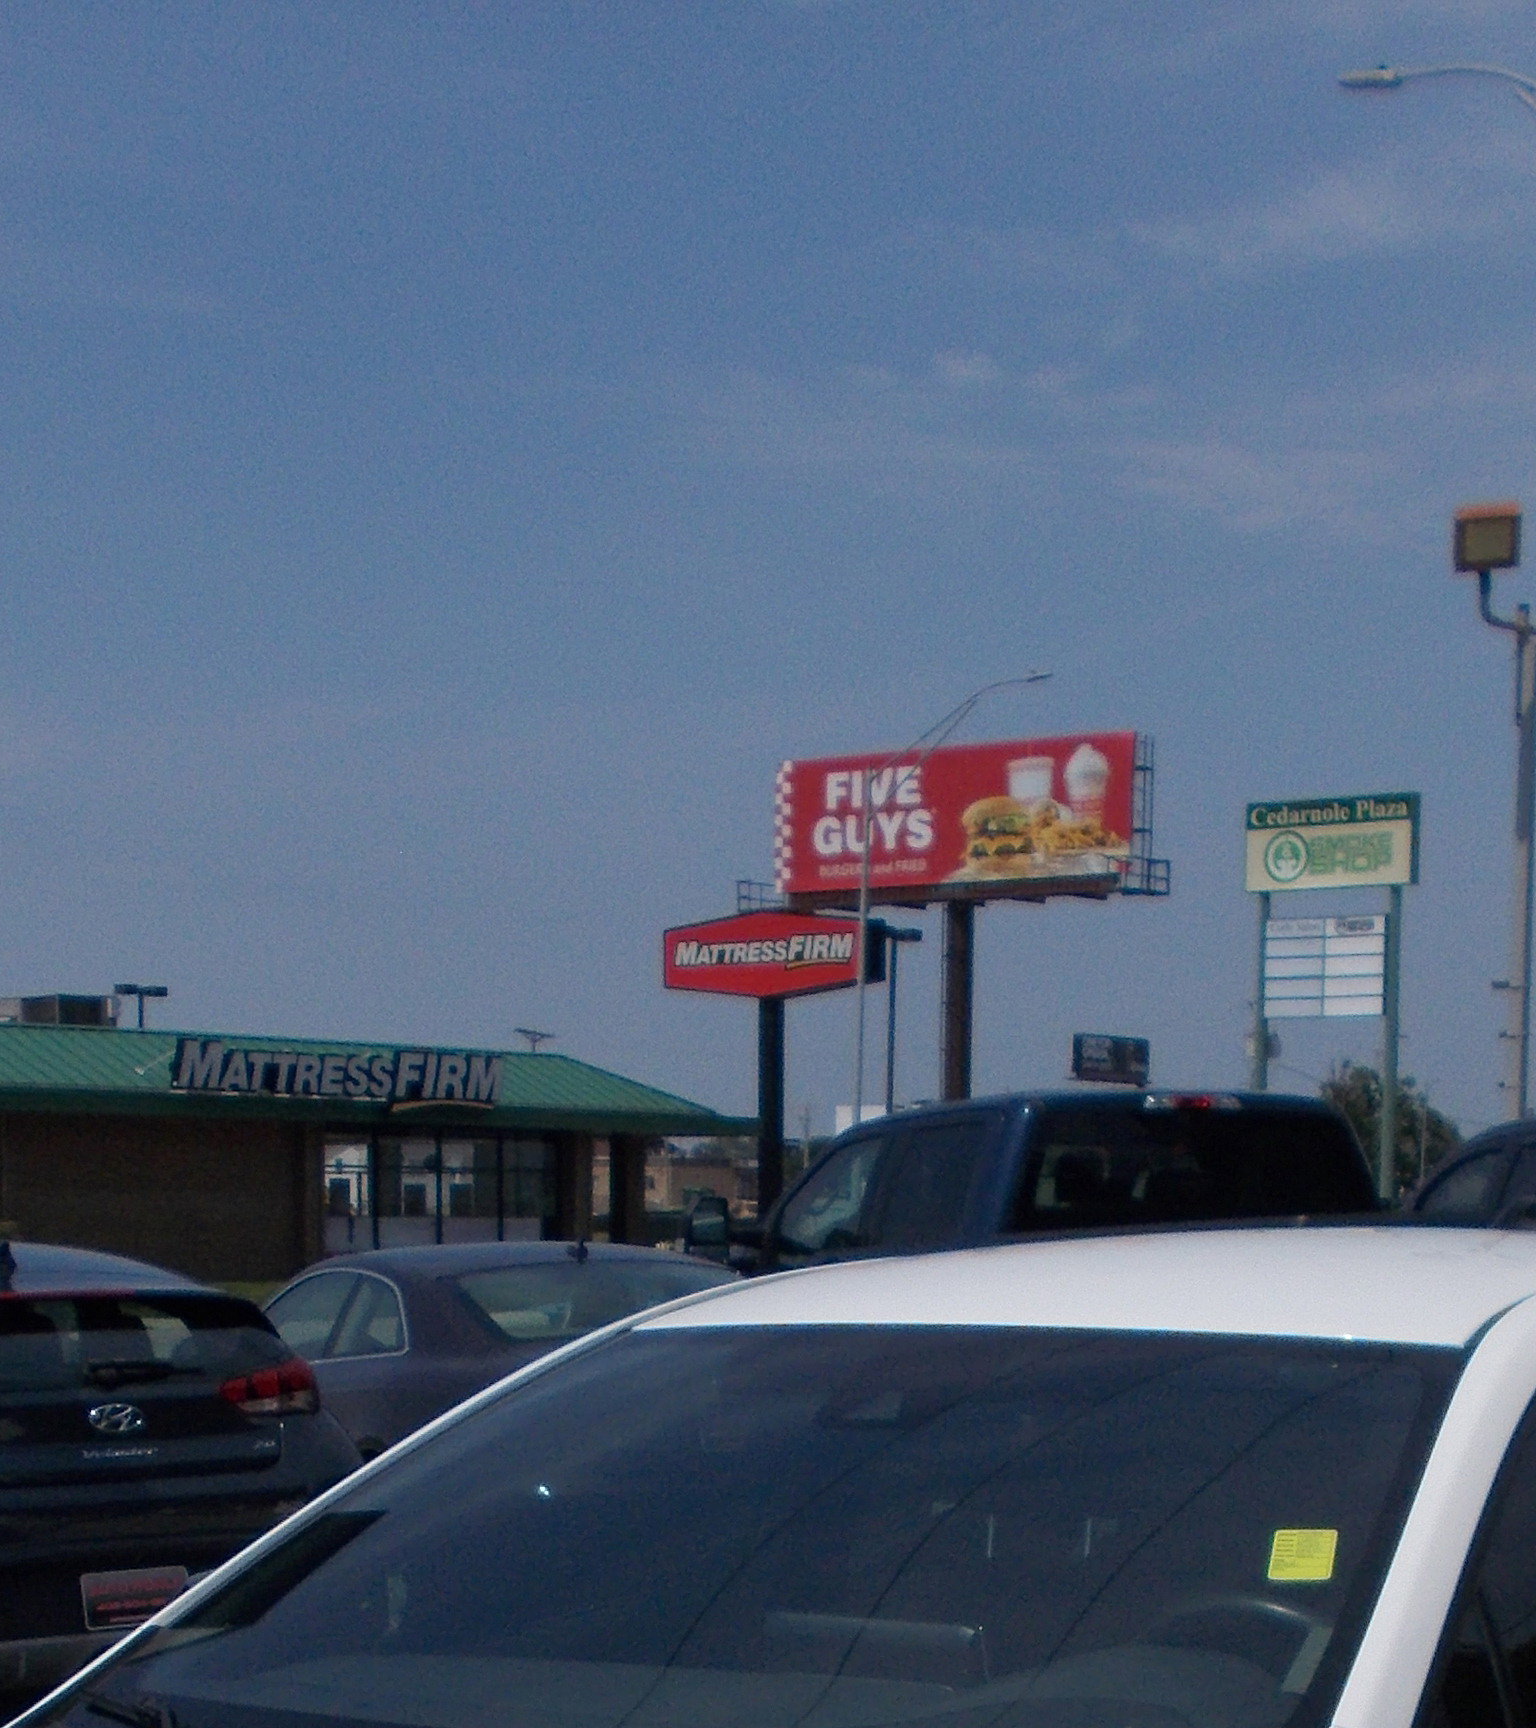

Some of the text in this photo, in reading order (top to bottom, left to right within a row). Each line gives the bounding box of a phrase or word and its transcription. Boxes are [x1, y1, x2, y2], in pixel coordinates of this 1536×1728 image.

[825, 766, 923, 811] FIVE
[1357, 800, 1408, 819] Plaza
[813, 808, 934, 855] GUYS
